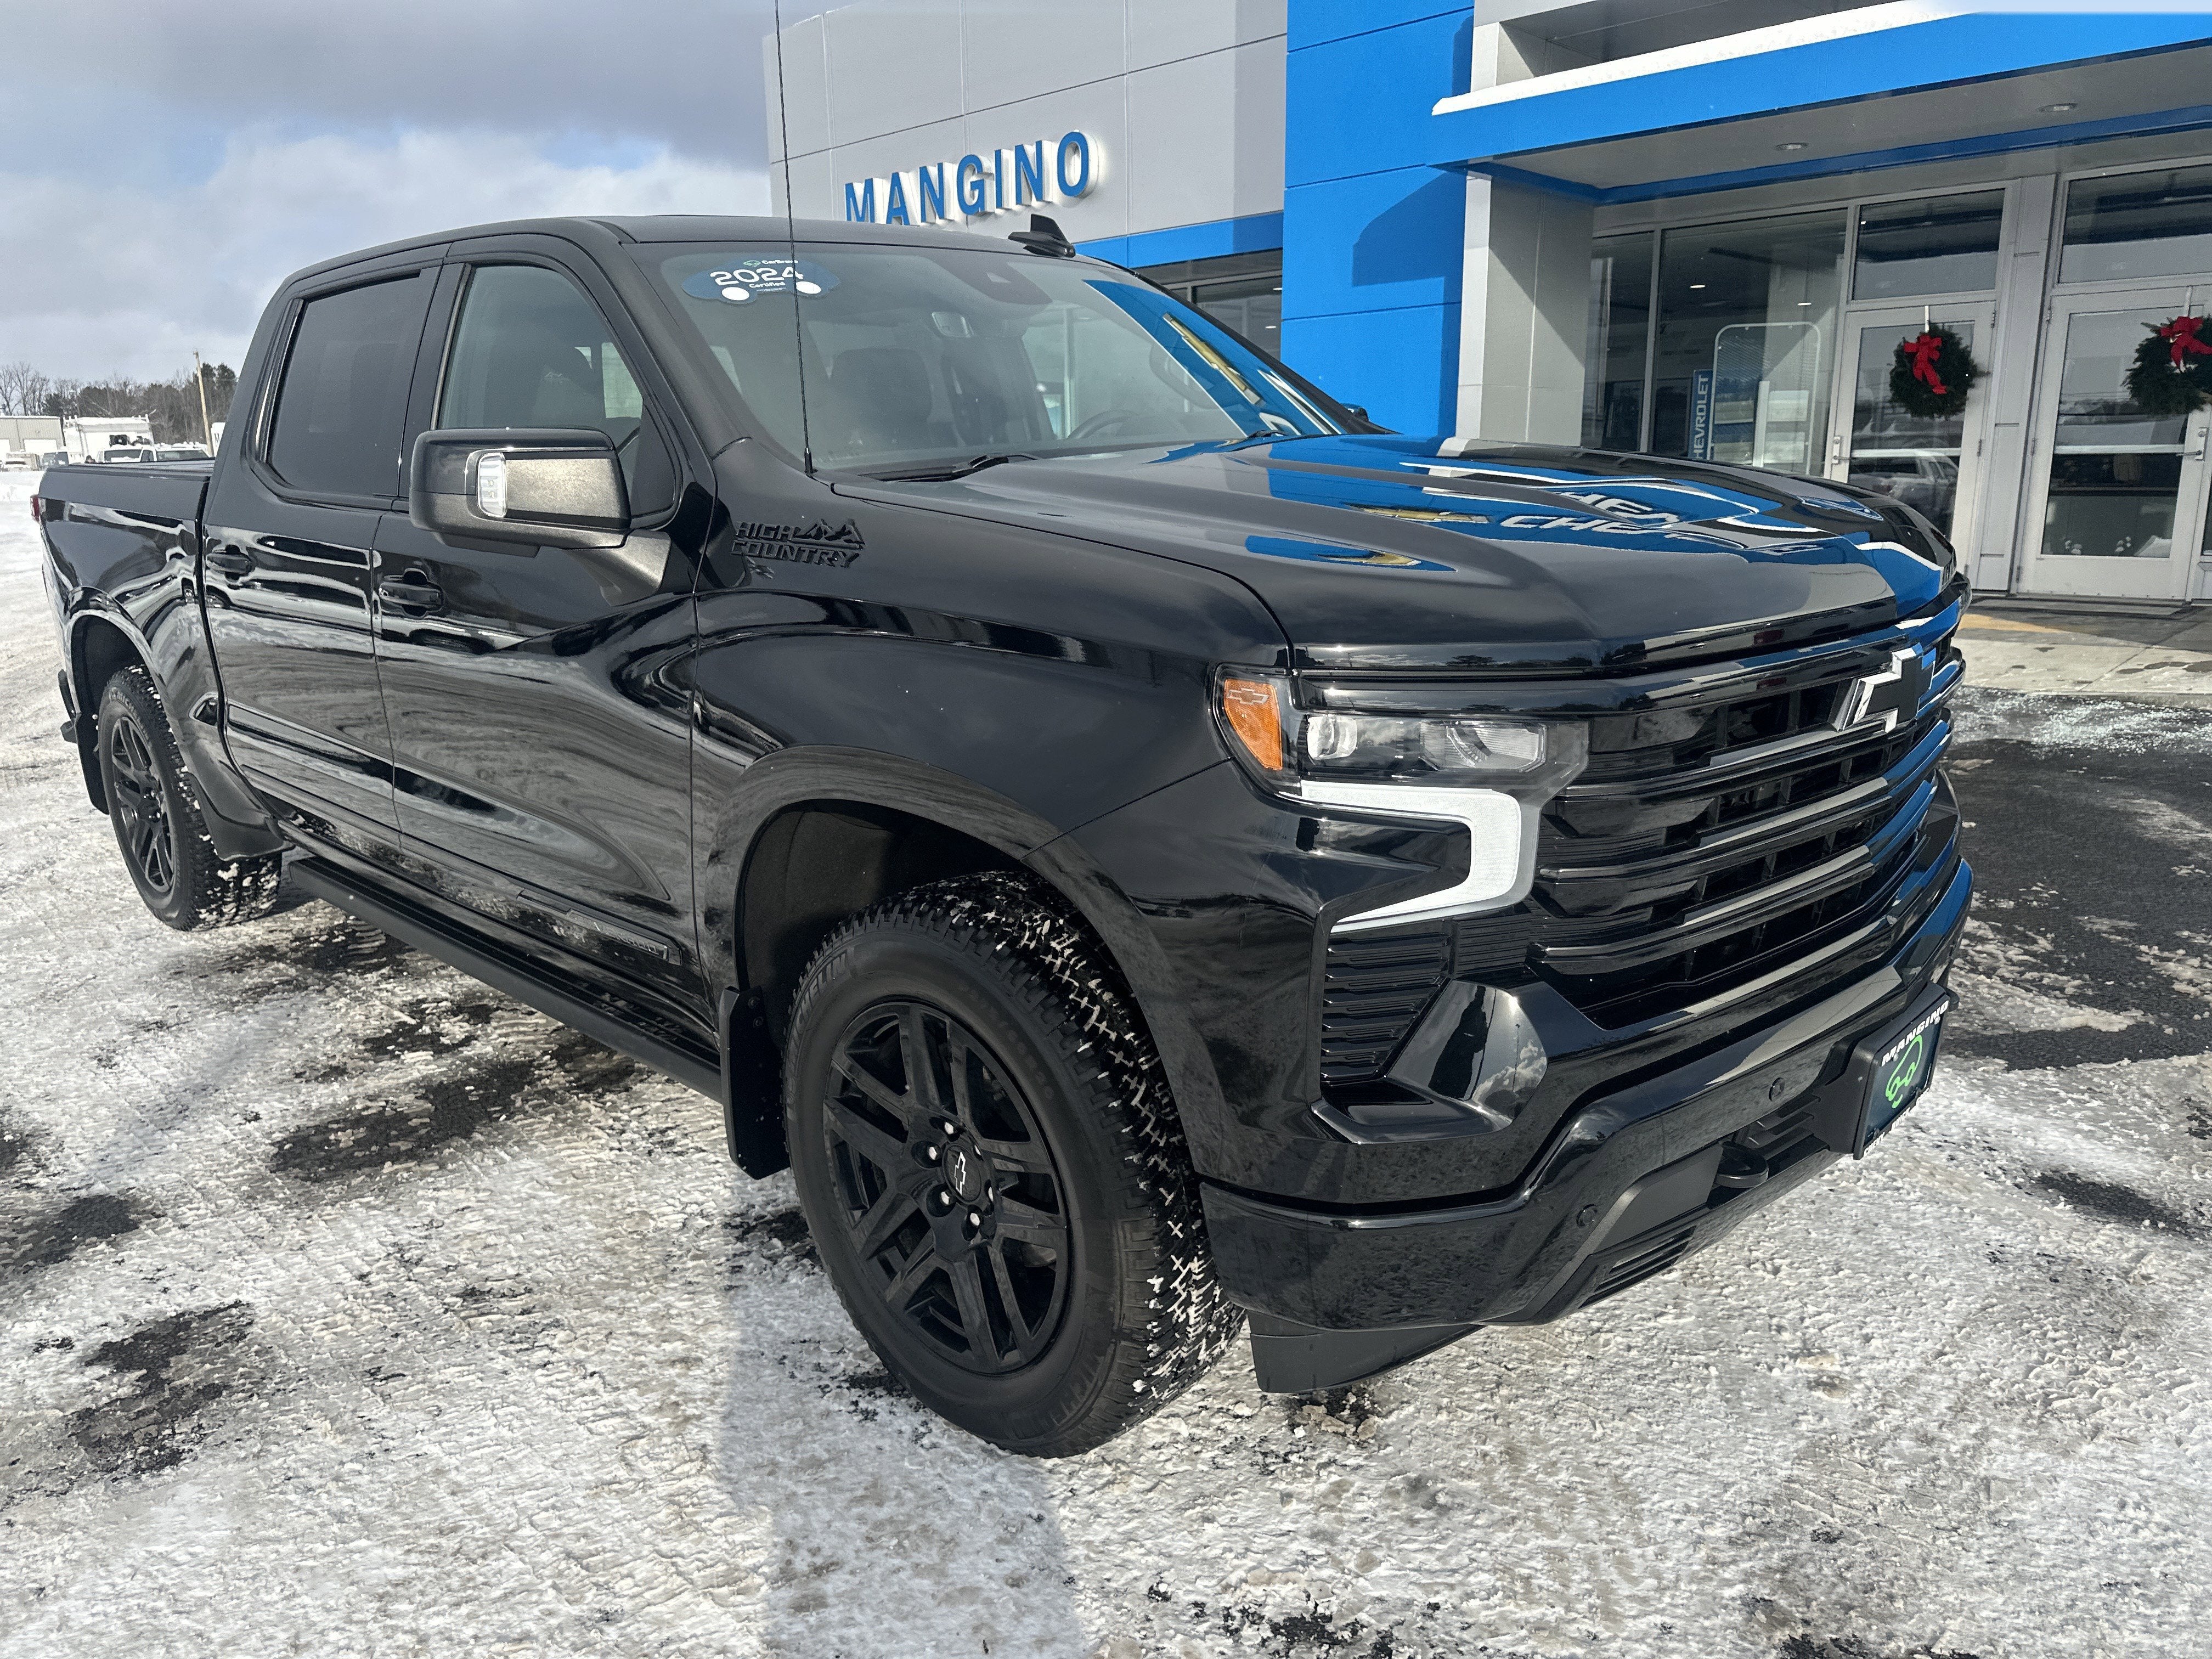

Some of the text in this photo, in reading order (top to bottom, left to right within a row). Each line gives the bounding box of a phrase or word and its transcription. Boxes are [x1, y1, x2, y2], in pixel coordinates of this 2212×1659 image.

[844, 131, 1096, 226] MANGINO
[710, 267, 804, 286] 2024
[1693, 374, 1709, 460] HEVROLET
[731, 540, 860, 568] COUNTRY
[736, 522, 797, 540] HIGH
[1881, 1000, 1949, 1067] MANGINO
